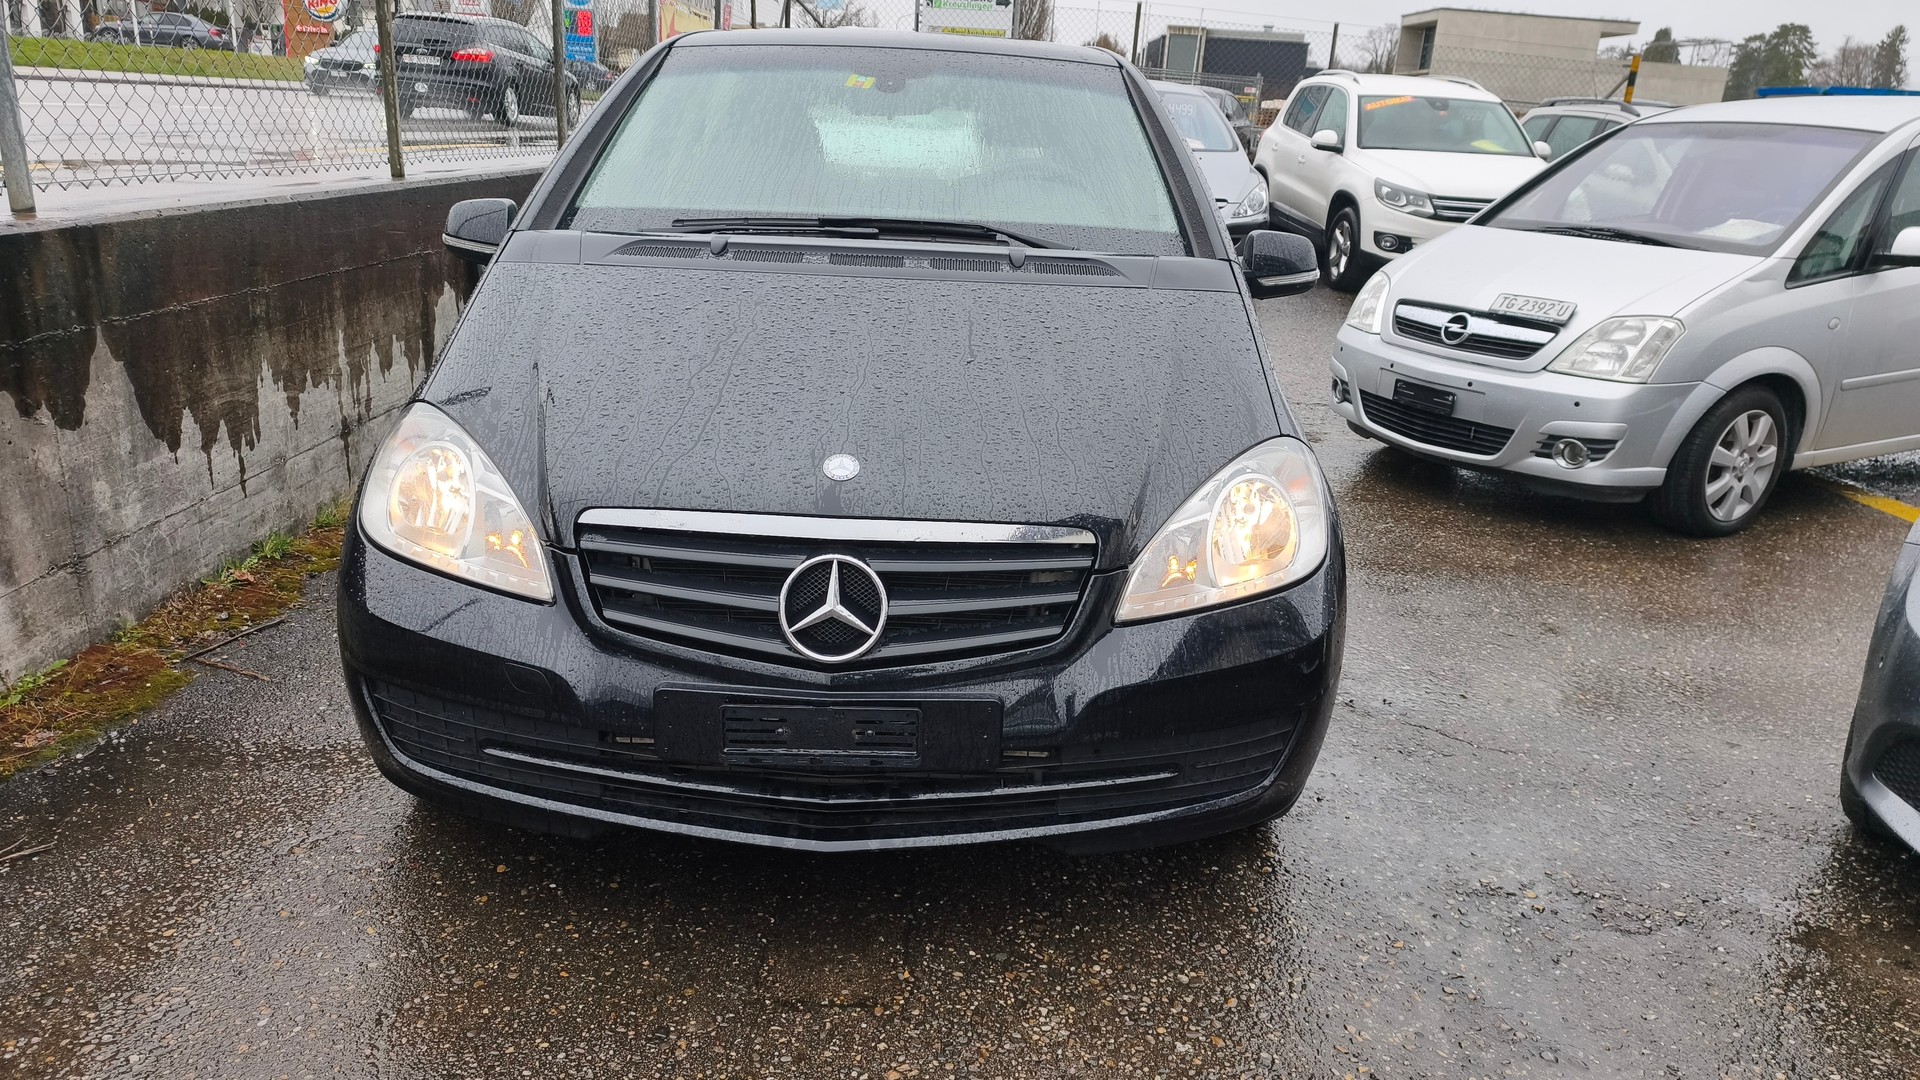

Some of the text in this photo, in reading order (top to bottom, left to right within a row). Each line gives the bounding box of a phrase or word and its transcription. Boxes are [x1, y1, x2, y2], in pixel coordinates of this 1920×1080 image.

[943, 1, 993, 10] Kreuzlingen
[1499, 296, 1517, 309] TG
[1518, 300, 1555, 314] 2392
[1557, 304, 1570, 317] U
